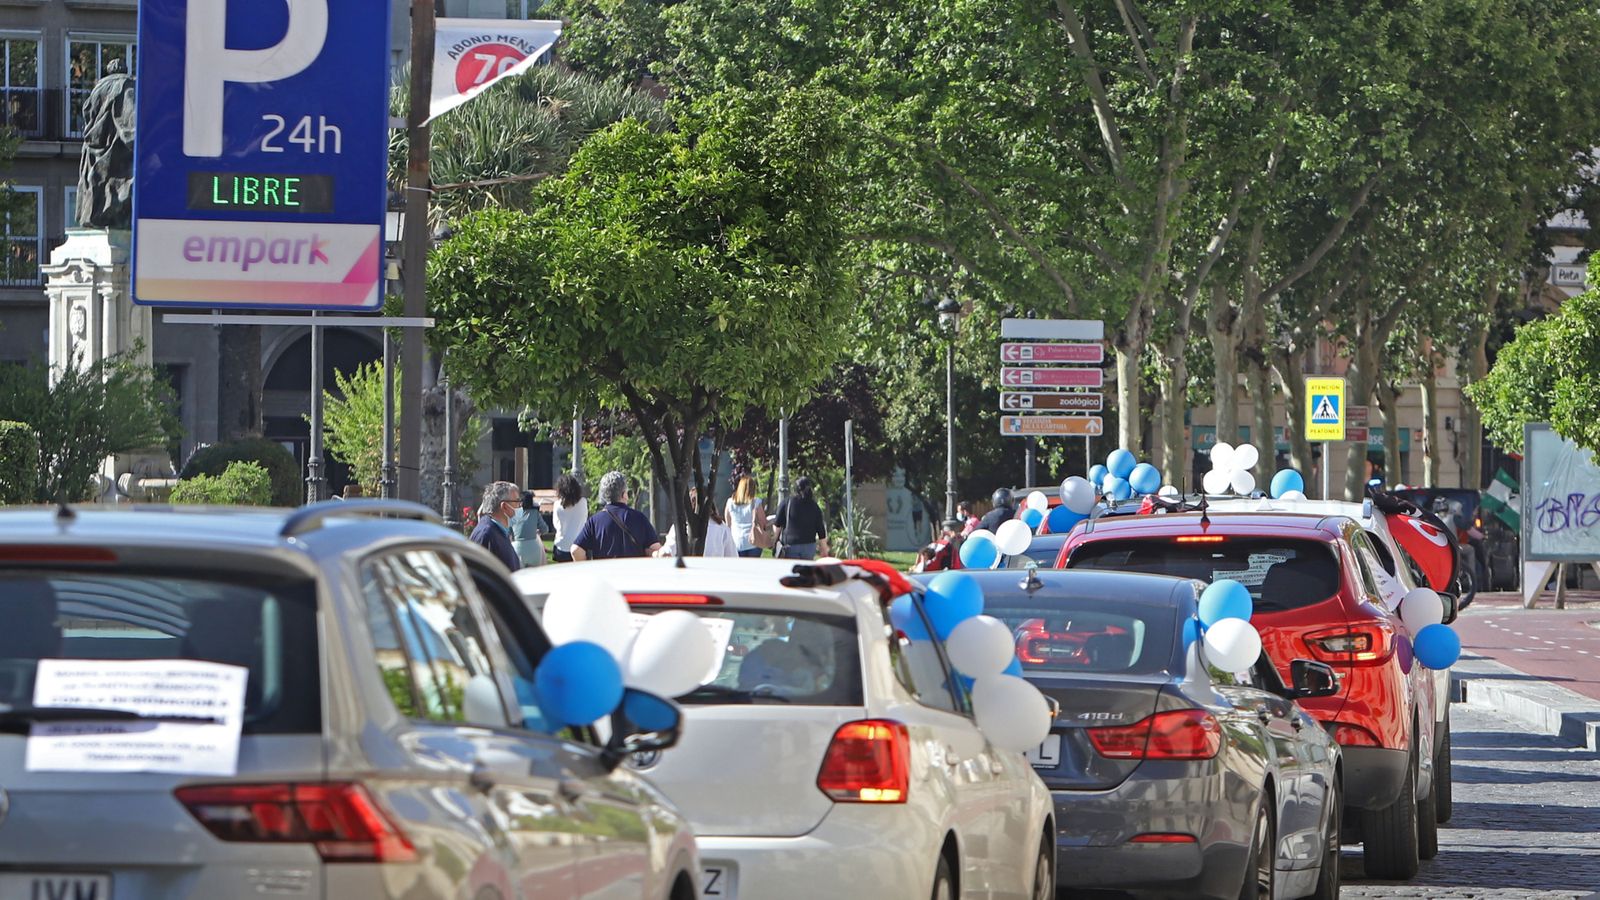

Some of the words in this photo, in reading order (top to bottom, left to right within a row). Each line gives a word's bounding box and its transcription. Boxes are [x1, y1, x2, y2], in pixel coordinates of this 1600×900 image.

[447, 34, 492, 60] ABONO
[183, 0, 329, 157] P
[260, 114, 342, 154] 24h
[212, 176, 301, 206] LIBRE
[182, 233, 330, 272] empark
[1059, 397, 1100, 407] zoológico
